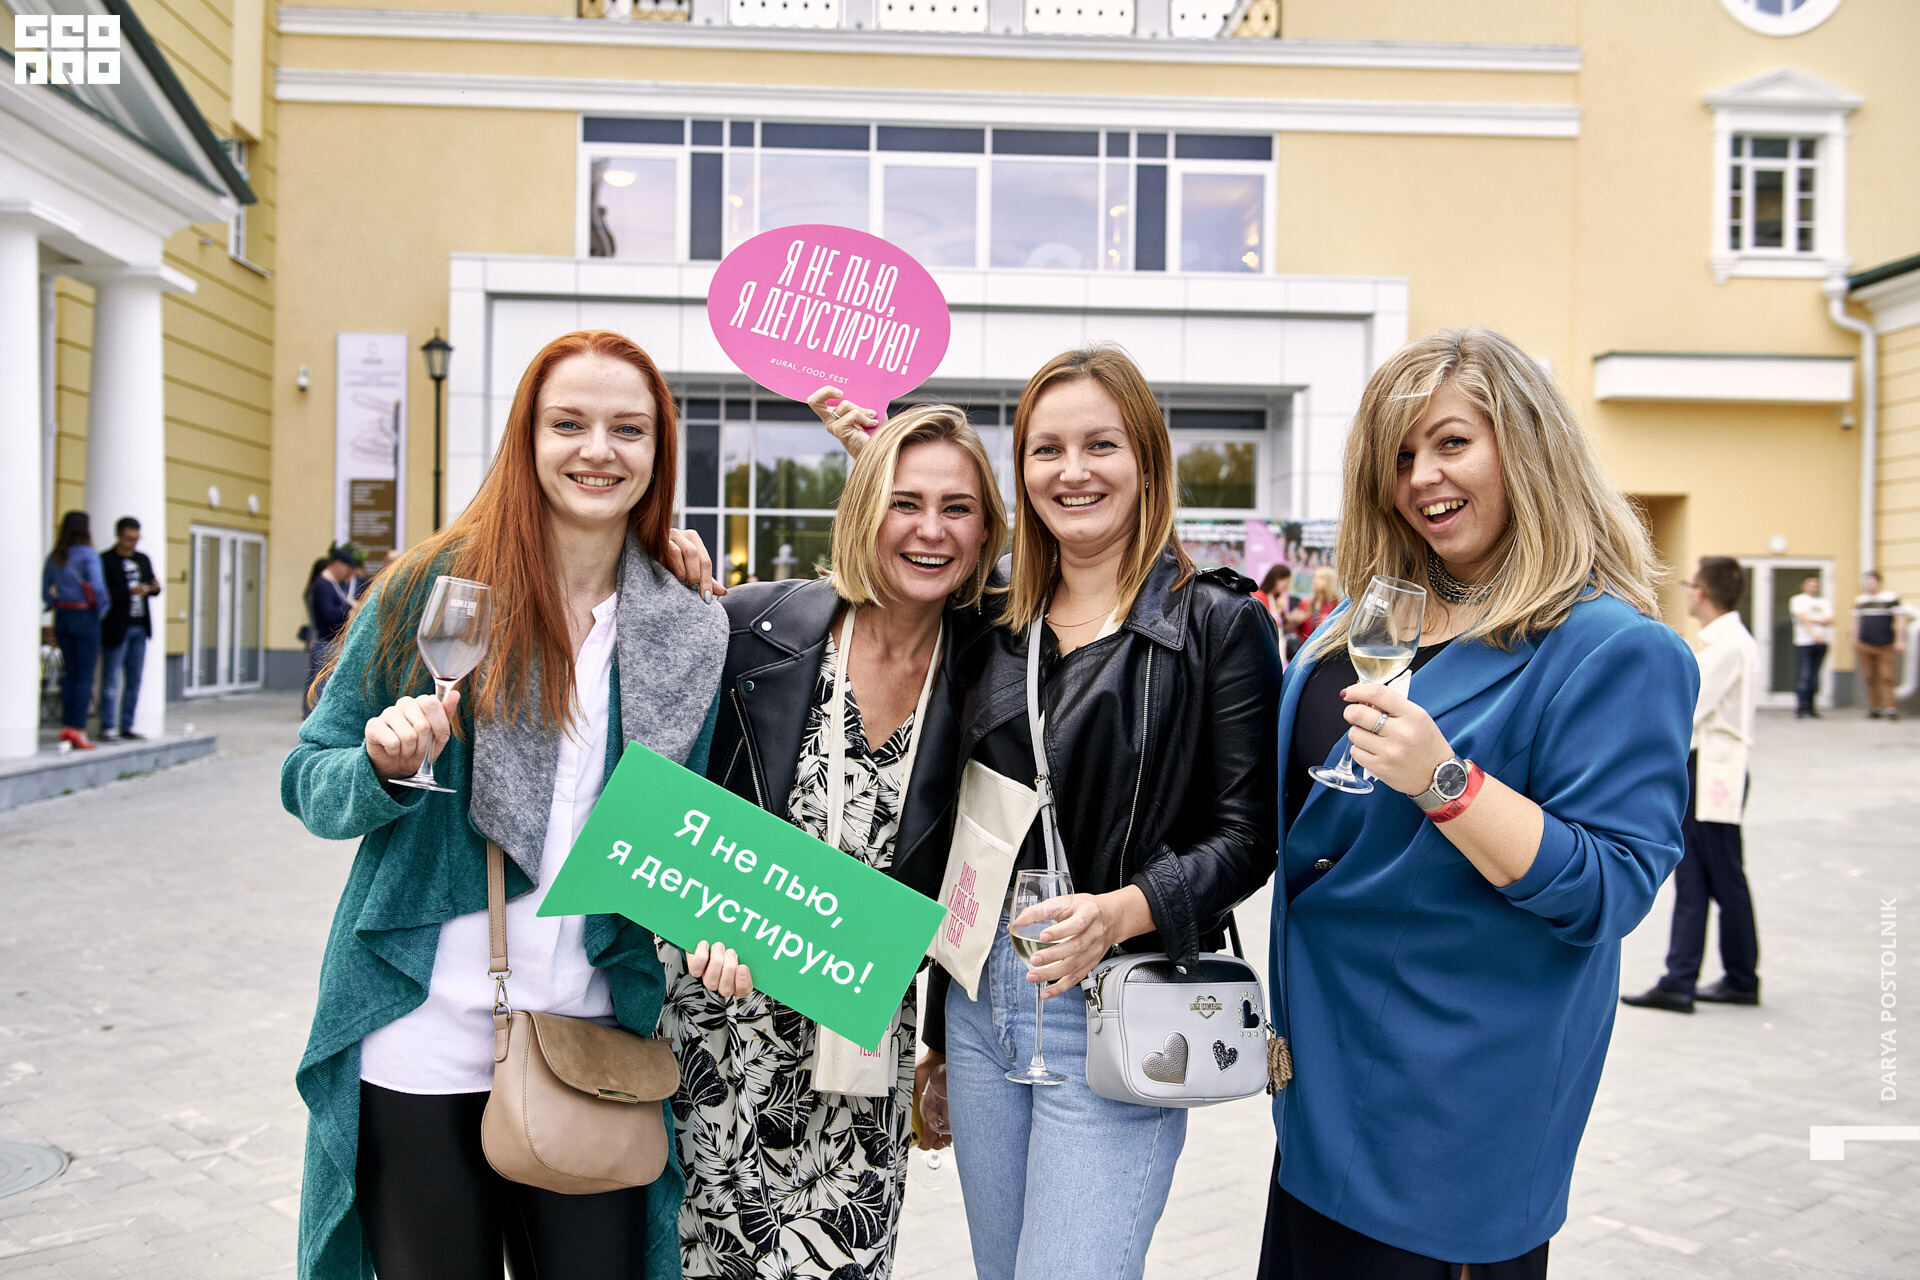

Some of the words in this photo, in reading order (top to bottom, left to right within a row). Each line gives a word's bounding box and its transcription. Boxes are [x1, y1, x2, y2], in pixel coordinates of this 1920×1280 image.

[777, 239, 805, 287] Я
[800, 244, 841, 297] НЕ
[836, 254, 899, 318] ПЬЮ,
[729, 280, 757, 329] Я
[750, 286, 921, 376] ДЕГУСТИРУЮ!
[769, 357, 849, 385] #URAL_FOOD_FEST
[674, 809, 711, 847] Я
[710, 835, 758, 873] не
[763, 863, 843, 929] пью,
[607, 840, 633, 866] я
[631, 855, 874, 995] дегустирую!
